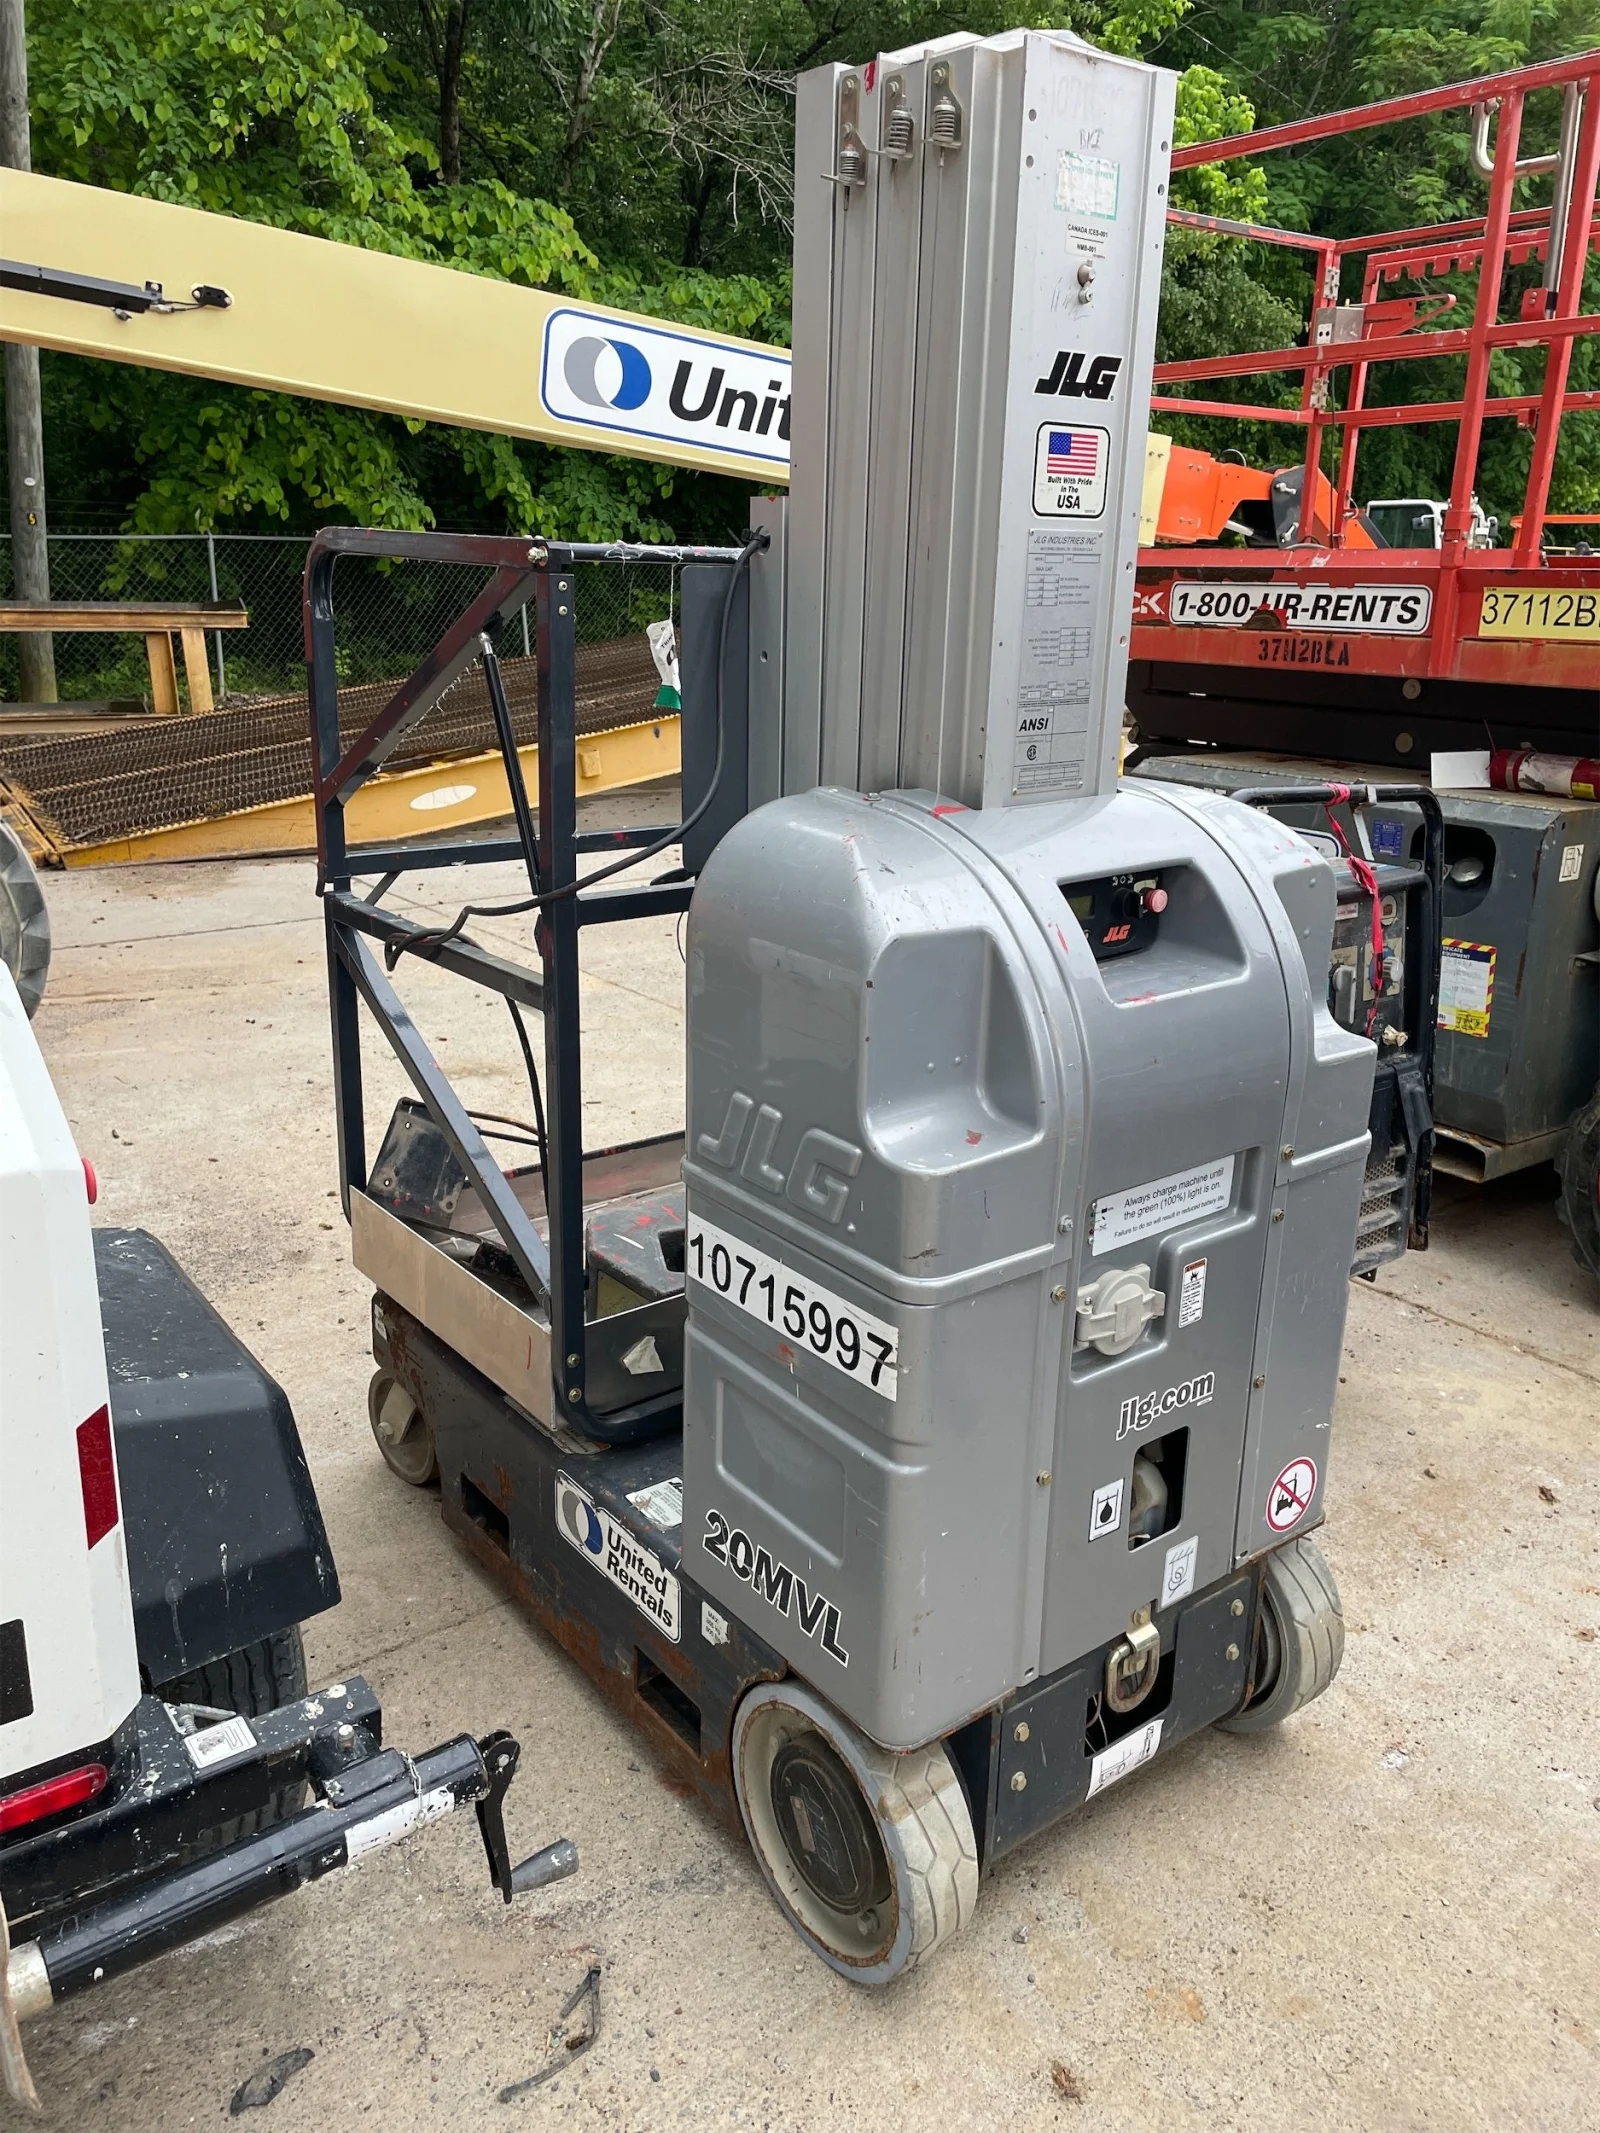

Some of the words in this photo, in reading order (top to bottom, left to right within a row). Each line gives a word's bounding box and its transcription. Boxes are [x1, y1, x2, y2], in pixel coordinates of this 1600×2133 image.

[1067, 223, 1088, 235] CANADA
[1034, 350, 1123, 401] JLG
[1047, 476, 1062, 484] Built
[1063, 476, 1077, 485] With
[1077, 478, 1093, 486] Pride
[1068, 485, 1079, 494] The
[1057, 494, 1081, 510] USA
[1034, 535, 1048, 545] JLG
[1047, 535, 1086, 546] INDUSTRIES
[1084, 536, 1098, 546] INC
[1178, 591, 1422, 625] 1-800-UR-RENTS
[1482, 593, 1600, 628] 37112B
[1018, 717, 1049, 732] ANSI
[1102, 924, 1132, 943] JLG
[697, 1090, 864, 1226] JLG
[1123, 1209, 1136, 1221] the
[1137, 1203, 1159, 1218] green
[1160, 1191, 1187, 1210] (100%)
[1187, 1185, 1203, 1200] light
[1203, 1184, 1210, 1193] is
[1210, 1181, 1222, 1191] on.
[1124, 1192, 1151, 1208] Always
[1152, 1184, 1178, 1199] charge
[1178, 1173, 1209, 1192] machine
[1209, 1166, 1225, 1180] until
[1114, 1228, 1132, 1239] Failure
[1138, 1222, 1146, 1230] do
[1153, 1216, 1162, 1225] will
[1162, 1211, 1176, 1222] result
[1181, 1203, 1201, 1215] reduced
[1201, 1198, 1217, 1209] battery
[690, 1232, 895, 1387] 10715997
[1116, 1371, 1215, 1441] jlg.com
[607, 1525, 668, 1598] United
[606, 1550, 673, 1628] Rentals
[702, 1508, 851, 1669] 20MVL
